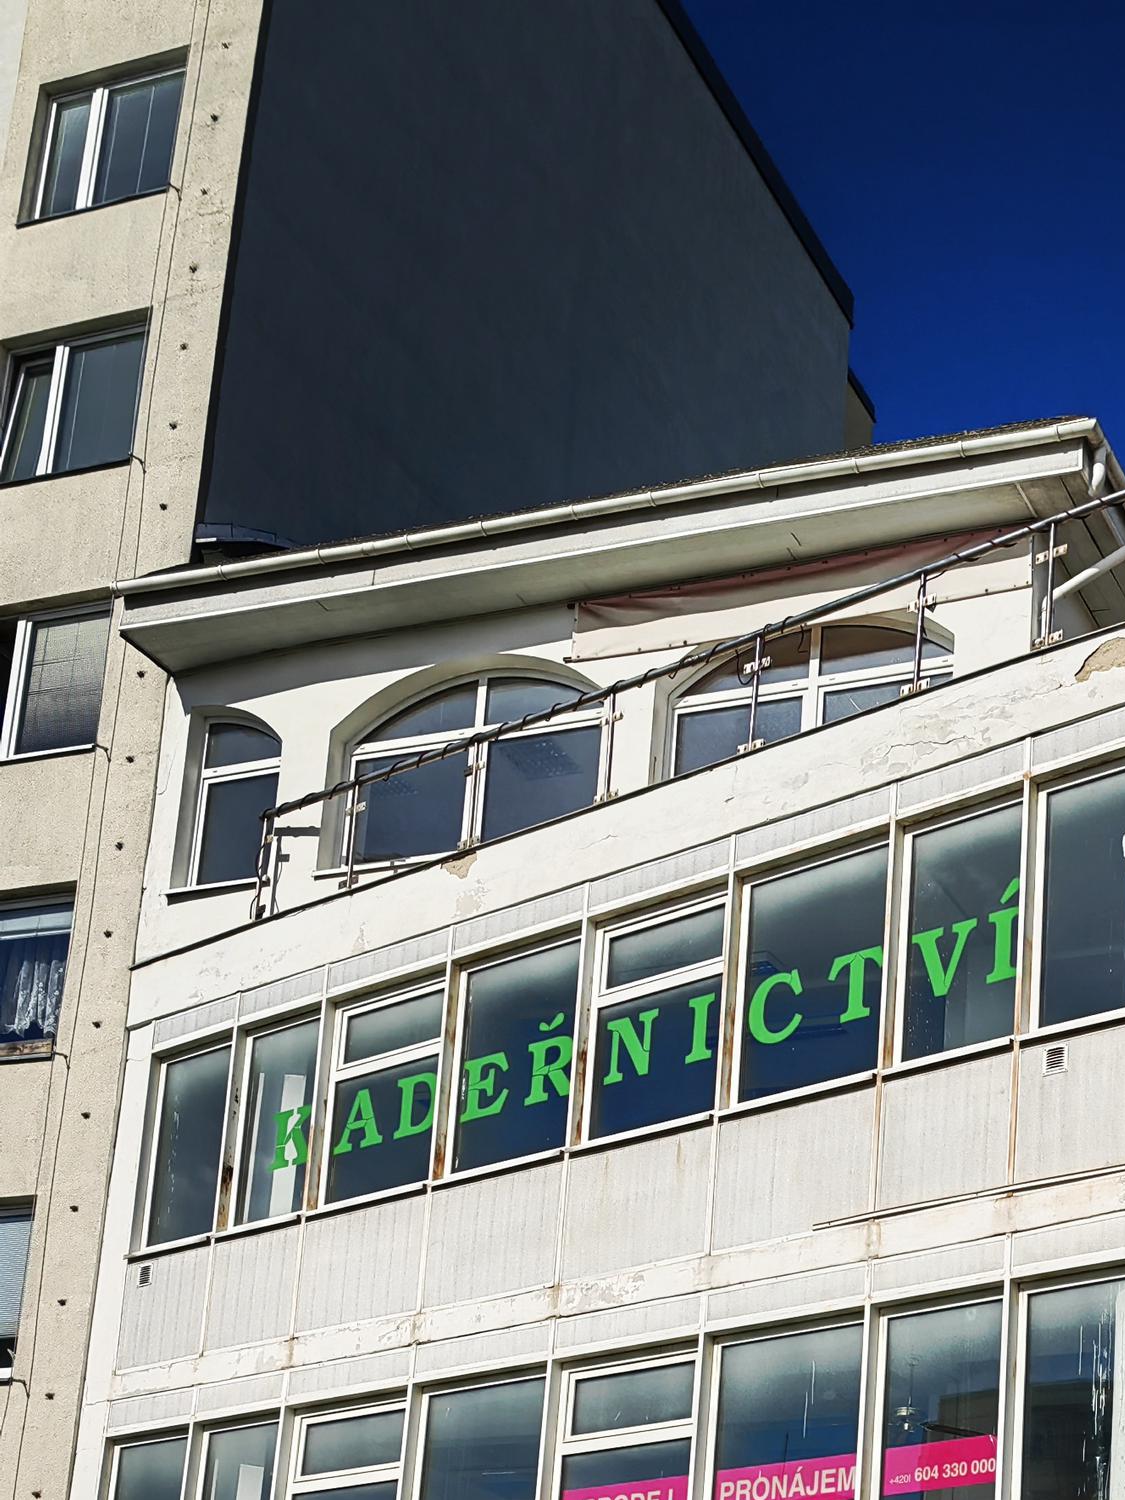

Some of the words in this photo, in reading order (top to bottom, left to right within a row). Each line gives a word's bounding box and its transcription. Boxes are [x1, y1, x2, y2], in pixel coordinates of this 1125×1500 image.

[268, 878, 1021, 1173] KADEŘNICTVÍ
[914, 1465, 939, 1482] 604
[942, 1461, 968, 1478] 330
[971, 1458, 996, 1474] 000
